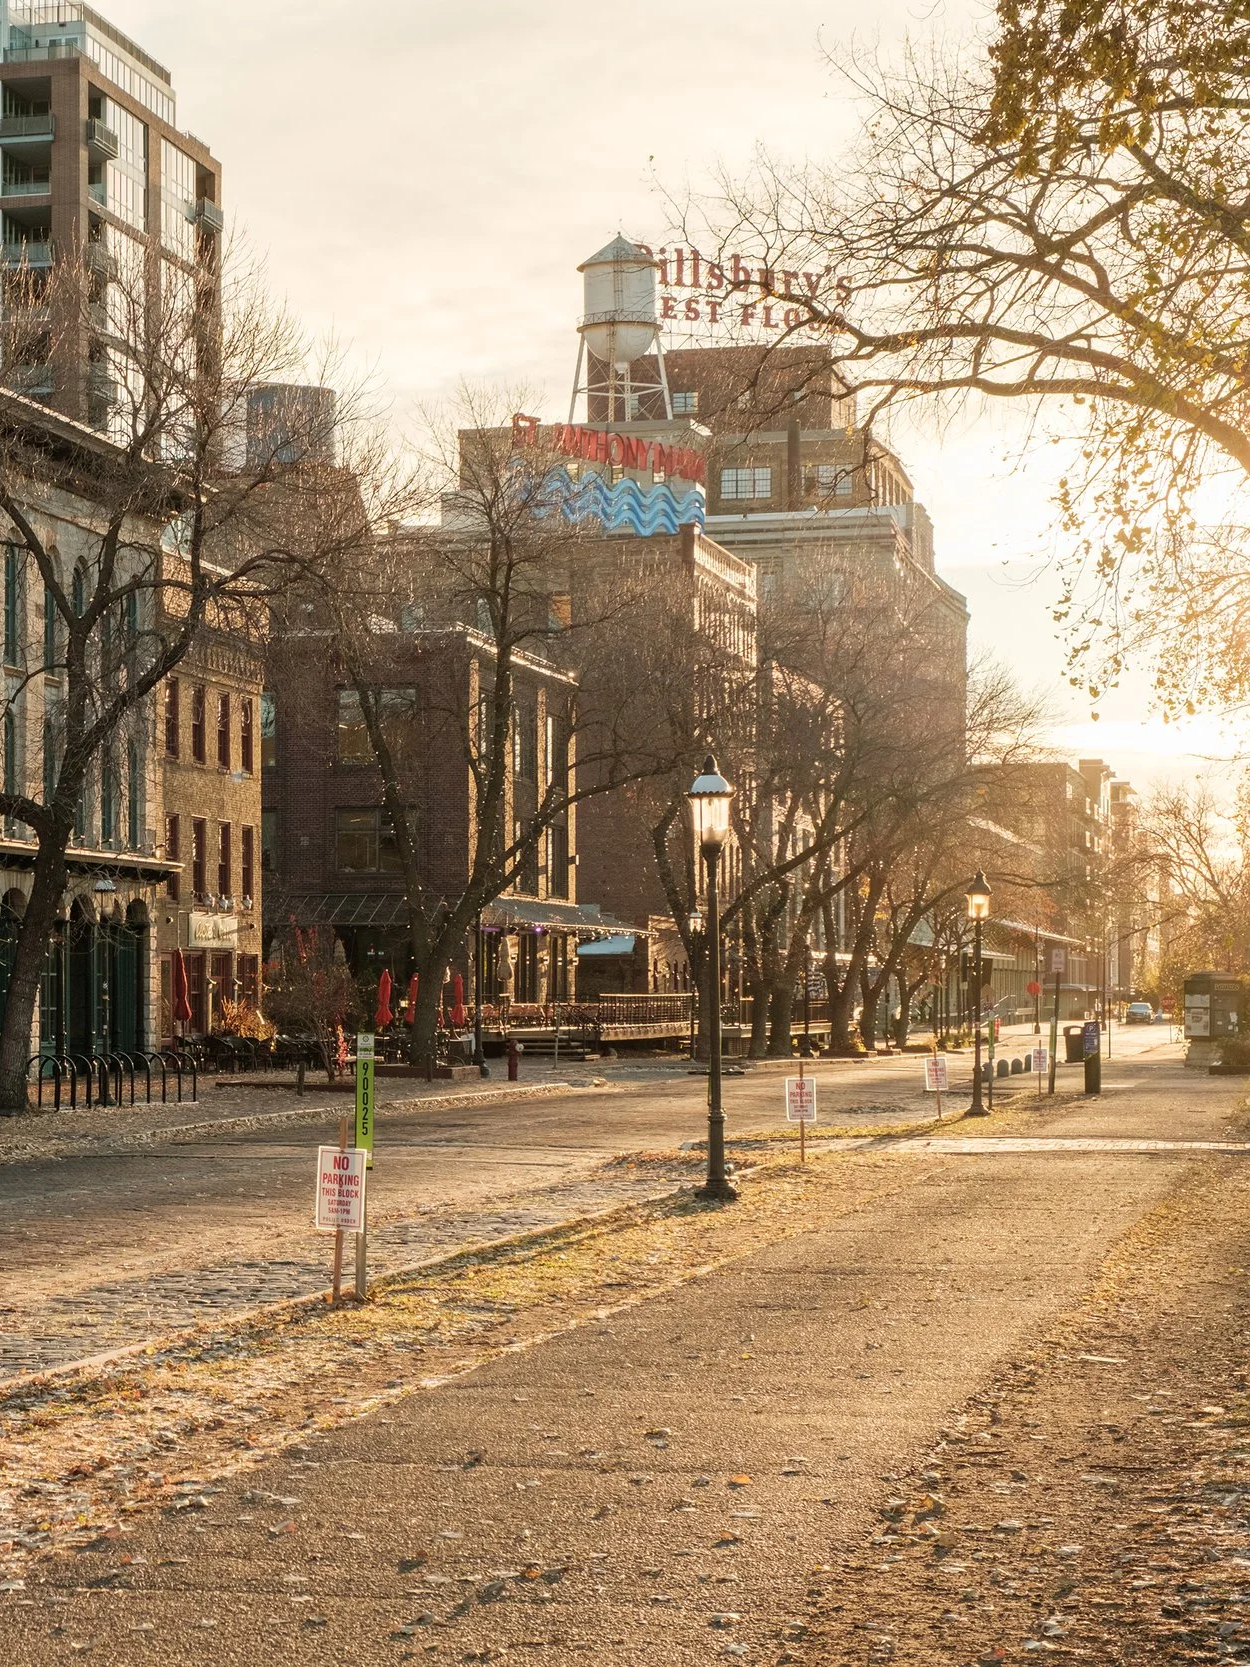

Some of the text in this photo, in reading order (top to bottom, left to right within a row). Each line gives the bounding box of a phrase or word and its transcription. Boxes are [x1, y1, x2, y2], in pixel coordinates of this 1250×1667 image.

[659, 296, 723, 323] EST
[796, 1082, 805, 1090] NO
[333, 1156, 349, 1171] NO
[322, 1173, 359, 1186] PARKING
[322, 1187, 359, 1199] THIS BLOCK
[328, 1199, 351, 1207] SATURDAY
